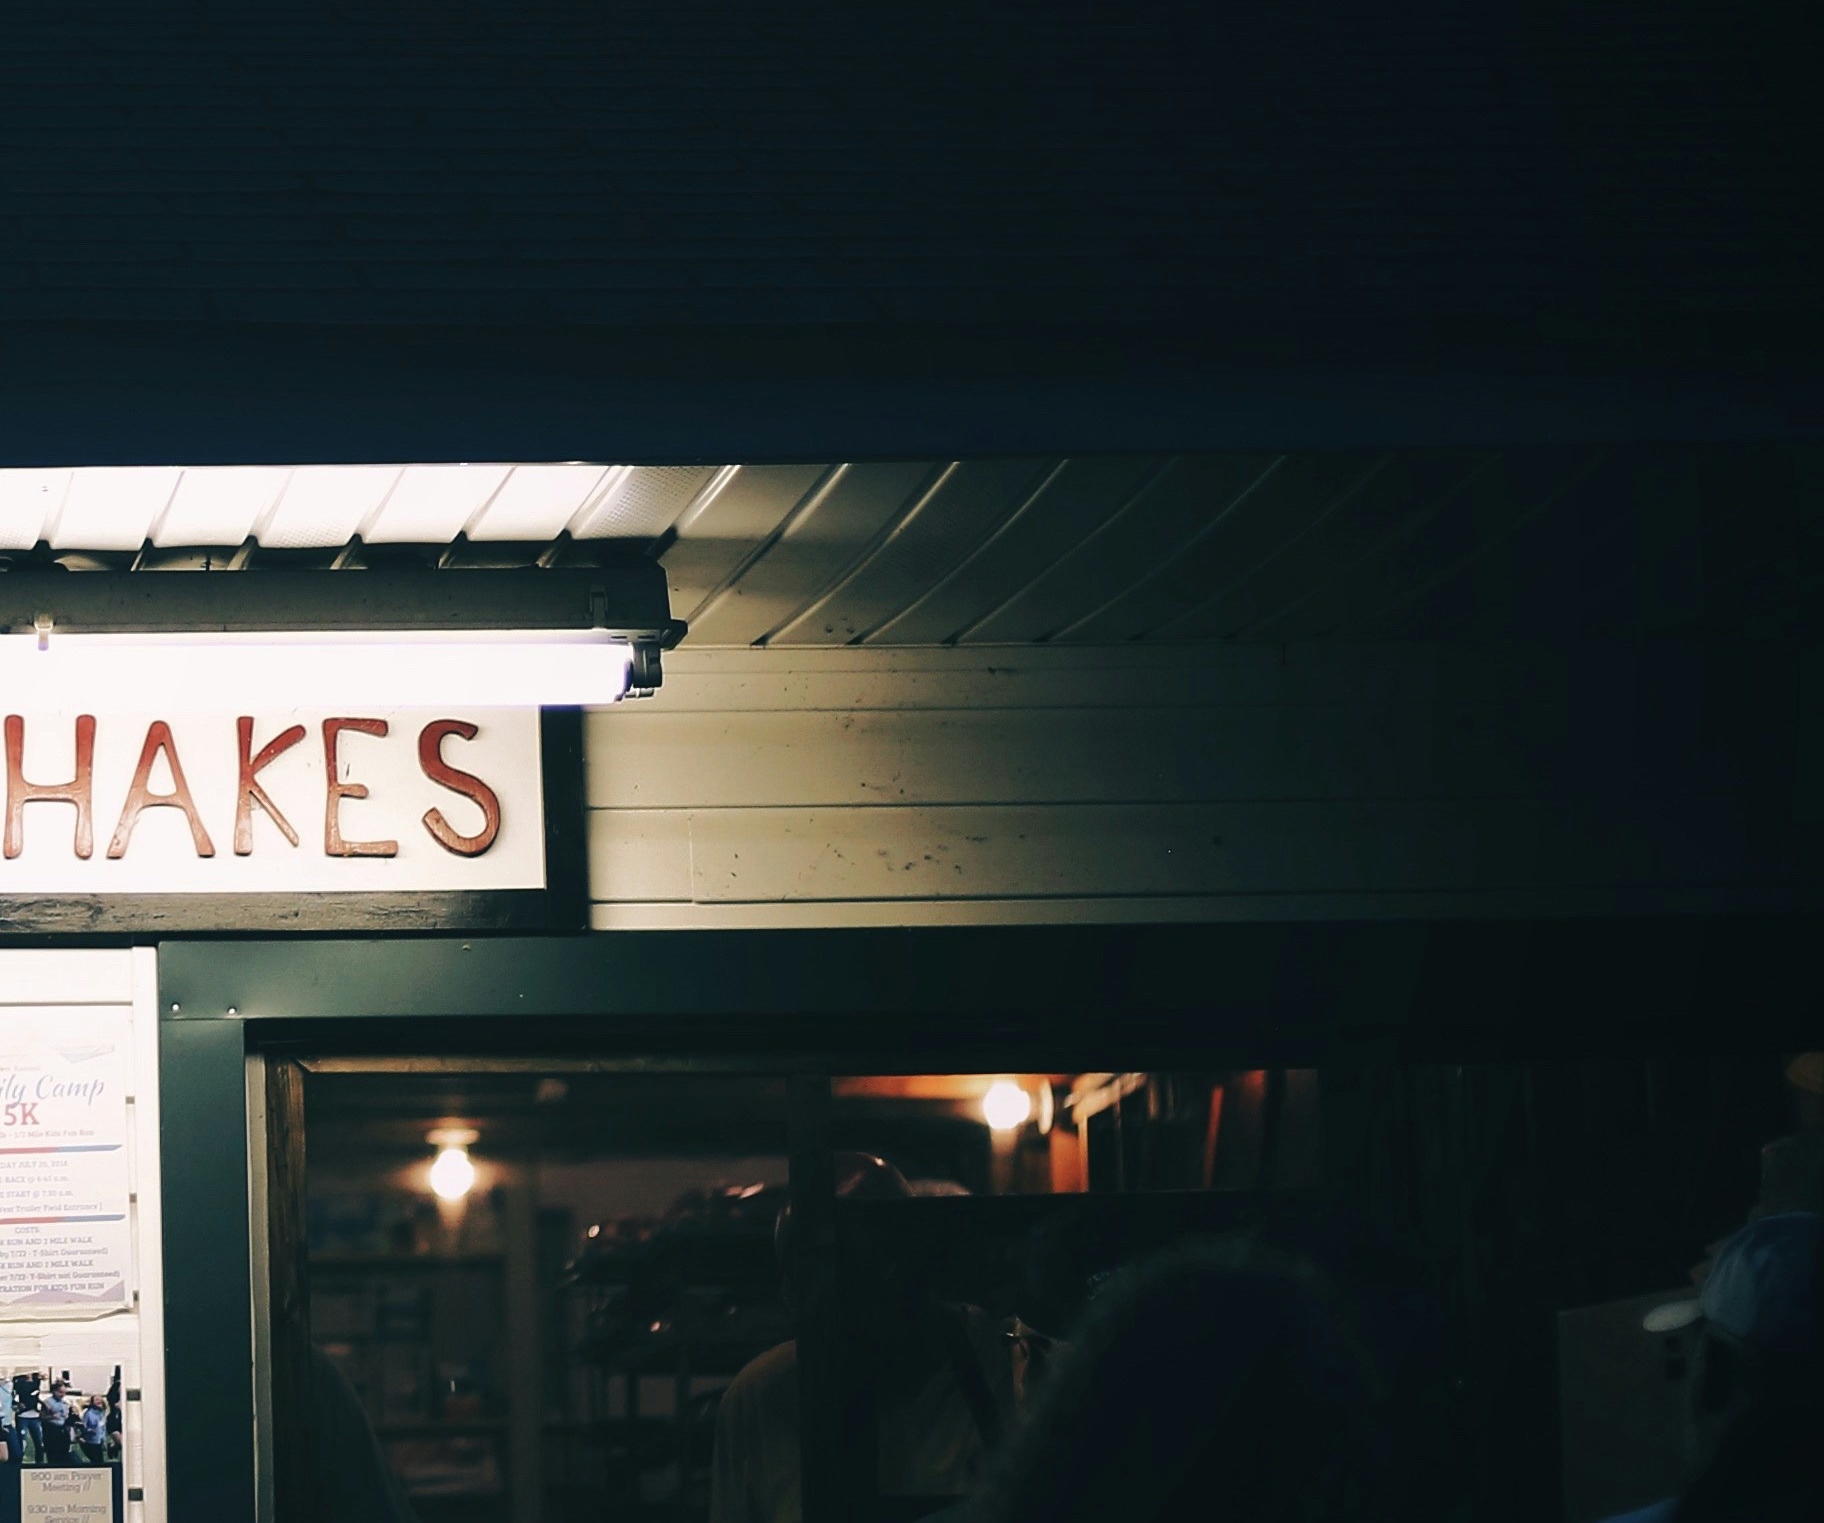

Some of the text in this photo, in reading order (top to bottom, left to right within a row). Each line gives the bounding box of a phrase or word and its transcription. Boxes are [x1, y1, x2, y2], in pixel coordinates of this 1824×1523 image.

[36, 1074, 105, 1106] Camp
[4, 1103, 40, 1125] 5K
[0, 1251, 8, 1259] by
[71, 1472, 102, 1484] Prayer
[42, 1482, 80, 1493] Meeting
[67, 1504, 106, 1515] Morning
[45, 1516, 79, 1523] Service
